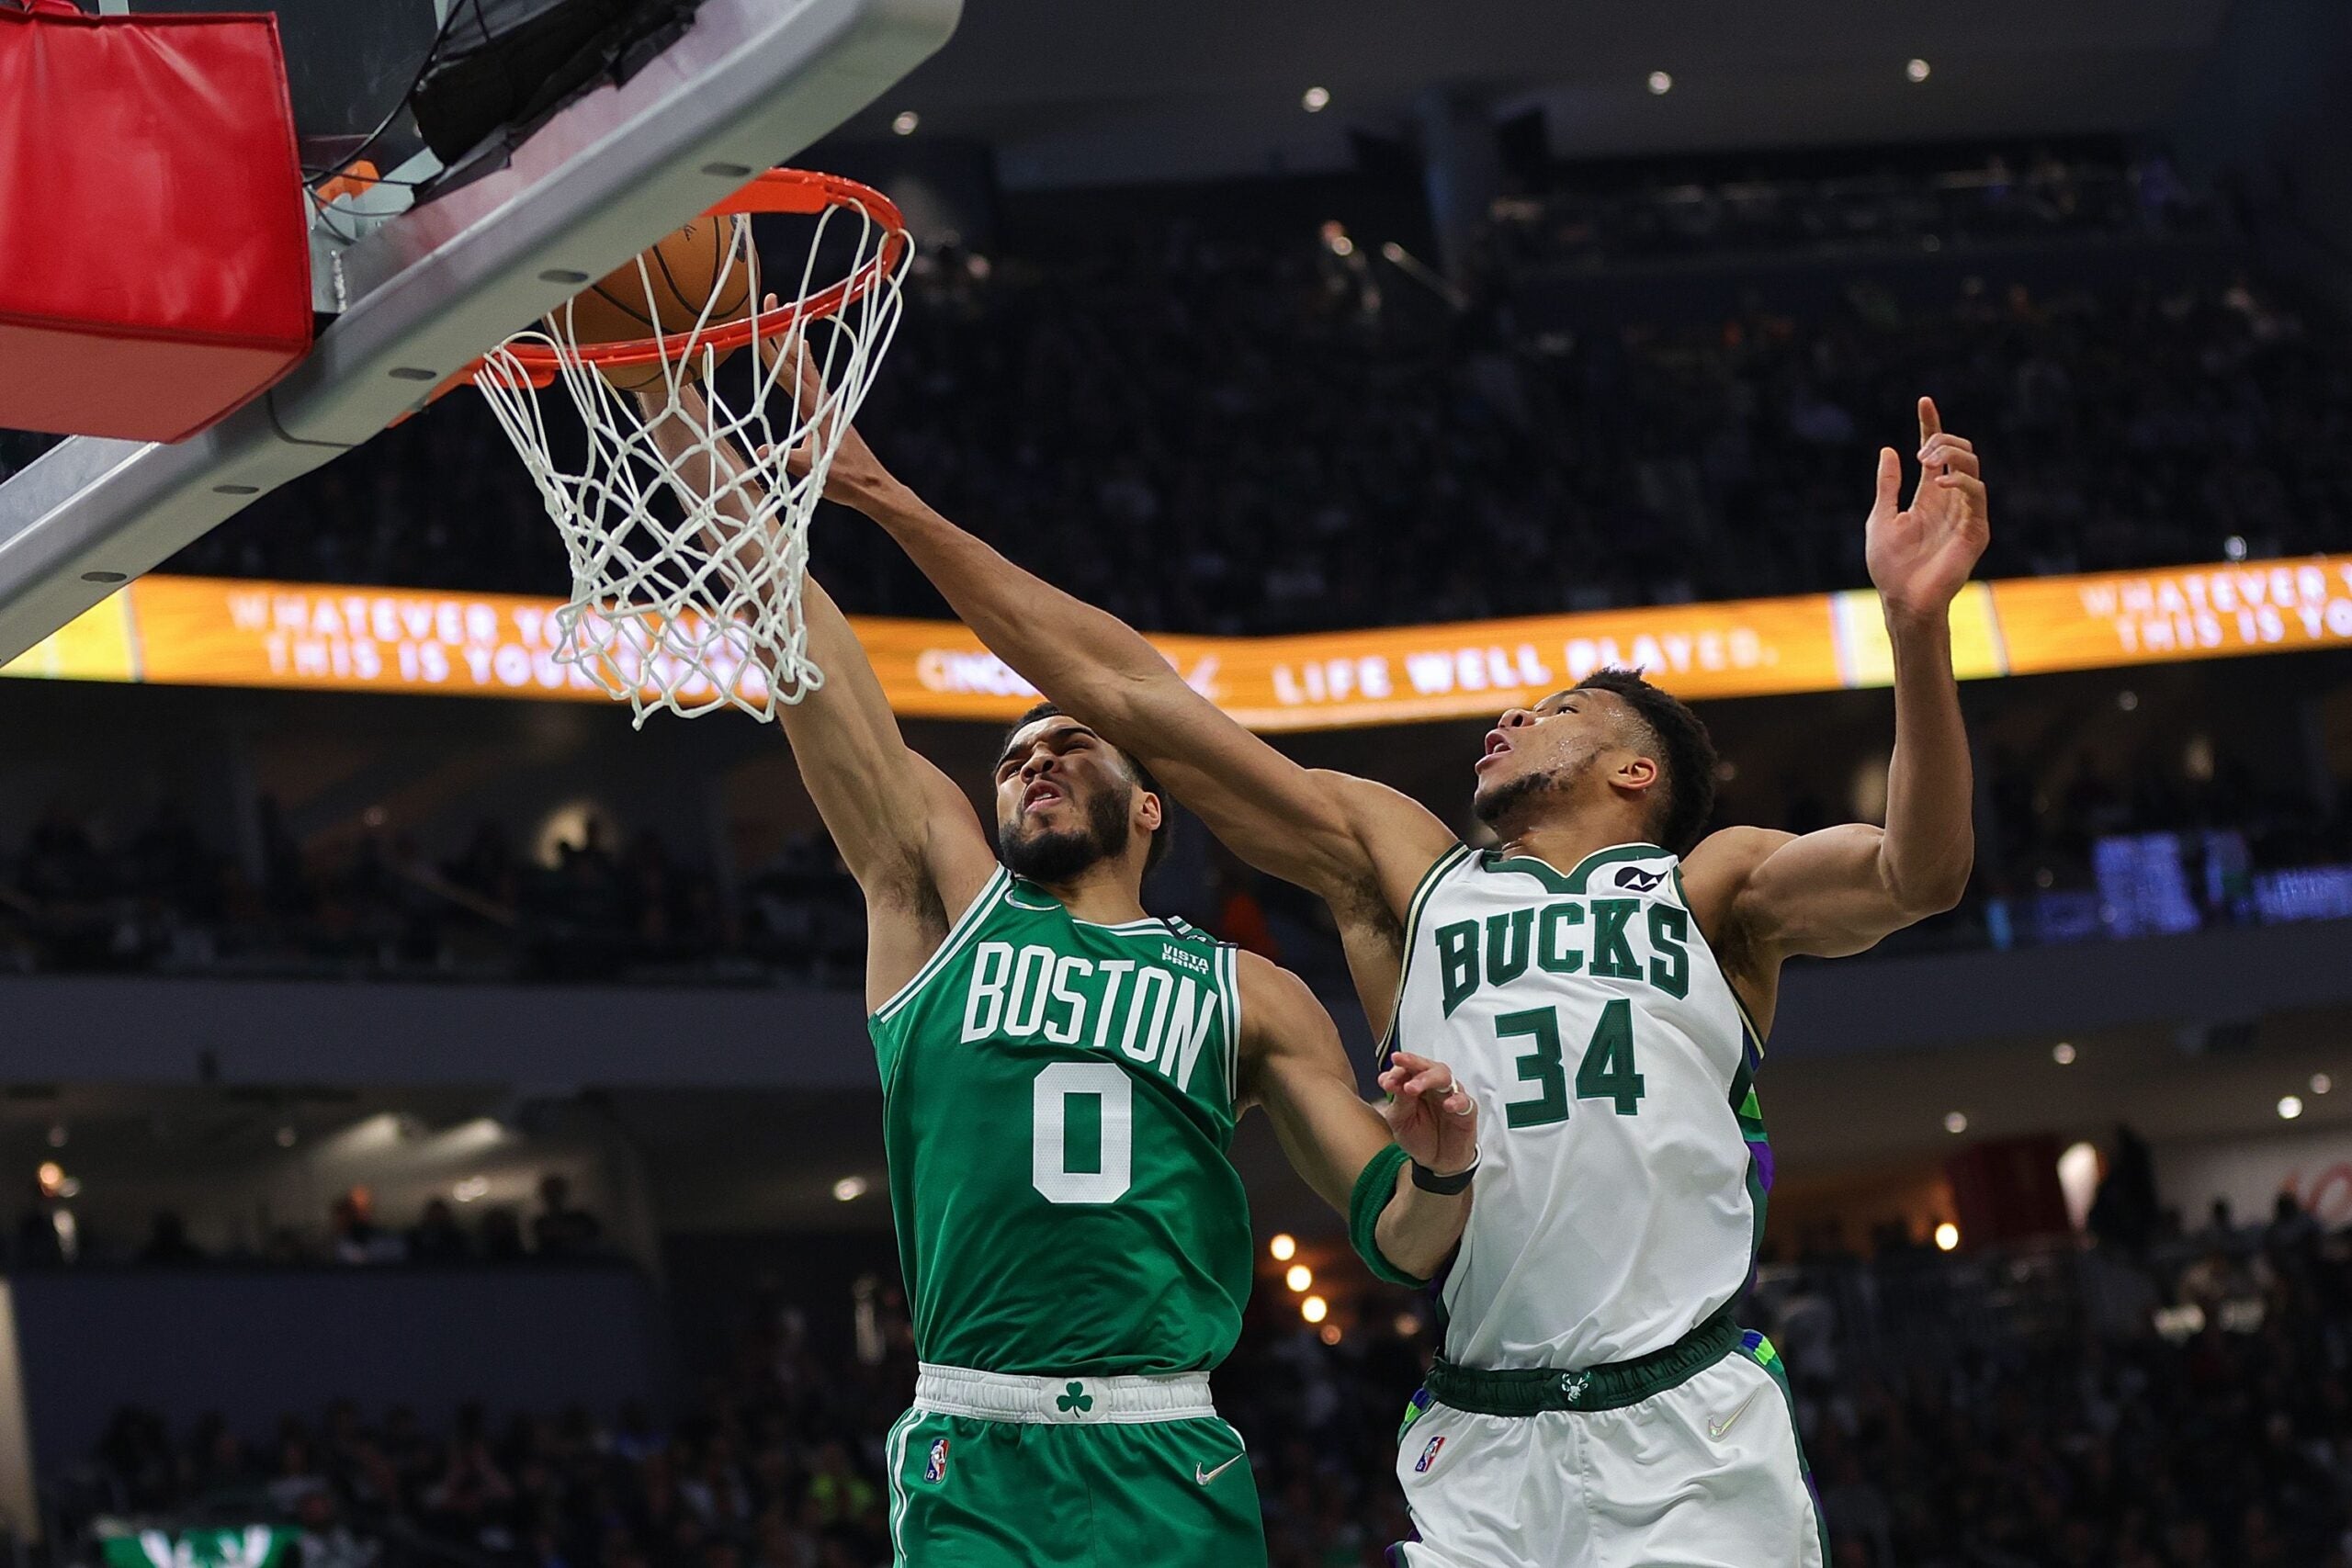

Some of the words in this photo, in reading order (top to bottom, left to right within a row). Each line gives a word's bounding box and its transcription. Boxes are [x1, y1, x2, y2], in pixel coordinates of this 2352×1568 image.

[227, 592, 497, 645] WHATEVER
[2078, 565, 2327, 619] WHATEVER
[2115, 607, 2223, 653] THIS
[2237, 603, 2285, 646] IS
[265, 633, 382, 680] THIS
[398, 639, 450, 683] IS
[1272, 656, 1393, 705] LIFE
[1405, 644, 1553, 694] WELL
[1161, 953, 1209, 975] PRINT
[1162, 942, 1209, 970] VISTA
[1434, 898, 1690, 1021] BUCKS
[961, 942, 1218, 1093] BOSTON
[1495, 998, 1645, 1129] 34
[1033, 1062, 1132, 1203] 0
